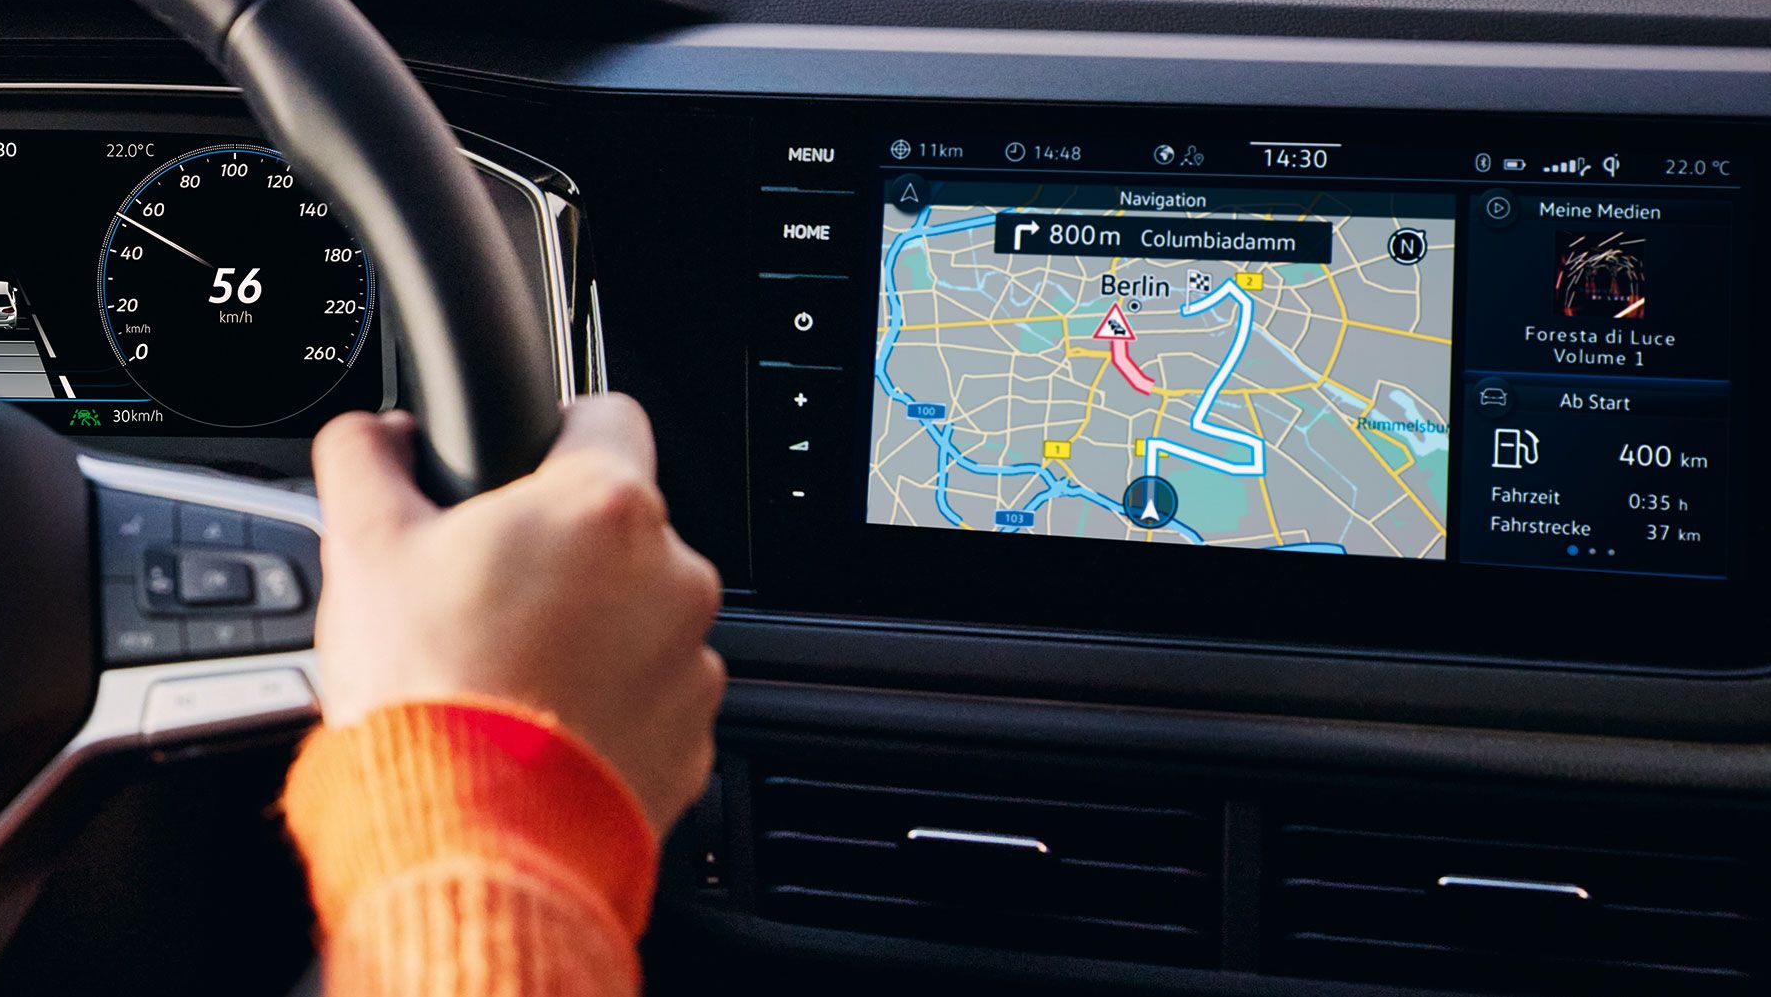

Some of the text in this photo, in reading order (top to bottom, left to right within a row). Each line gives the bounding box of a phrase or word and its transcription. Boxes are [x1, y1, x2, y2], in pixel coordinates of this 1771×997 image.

[107, 143, 154, 157] 22.0°C
[788, 148, 834, 162] MENU
[920, 143, 962, 157] 11km
[1035, 146, 1081, 160] 14:48
[1263, 147, 1328, 168] 14:30
[222, 164, 248, 177] 100
[1666, 160, 1730, 175] 22.0 °C
[180, 175, 200, 188] 80
[268, 175, 293, 188] 120
[1119, 190, 1207, 210] Navigation
[142, 203, 165, 217] 60
[300, 203, 327, 216] 140
[1540, 202, 1660, 219] Meine Medien
[784, 224, 830, 240] HOME
[1141, 230, 1295, 250] Columbiadamm
[1402, 239, 1413, 254] N
[120, 246, 143, 260] 40
[325, 249, 352, 262] 180
[209, 268, 261, 303] 56
[1102, 275, 1169, 296] Berlin
[117, 298, 138, 312] 20
[324, 300, 356, 314] 220
[220, 311, 252, 323] km/h
[126, 324, 150, 333] km/h
[1526, 326, 1675, 346] Foresta di Luce
[135, 344, 149, 360] 0
[304, 347, 336, 360] 260
[1554, 348, 1643, 366] Volume 1
[1560, 393, 1630, 411] Ab Start
[916, 406, 936, 416] 100
[1620, 444, 1707, 468] 400 km
[1492, 487, 1687, 511] Fahrzeit 0:35 h
[1005, 513, 1025, 524] 103
[1491, 516, 1700, 541] Fahrstrecke 37 km
